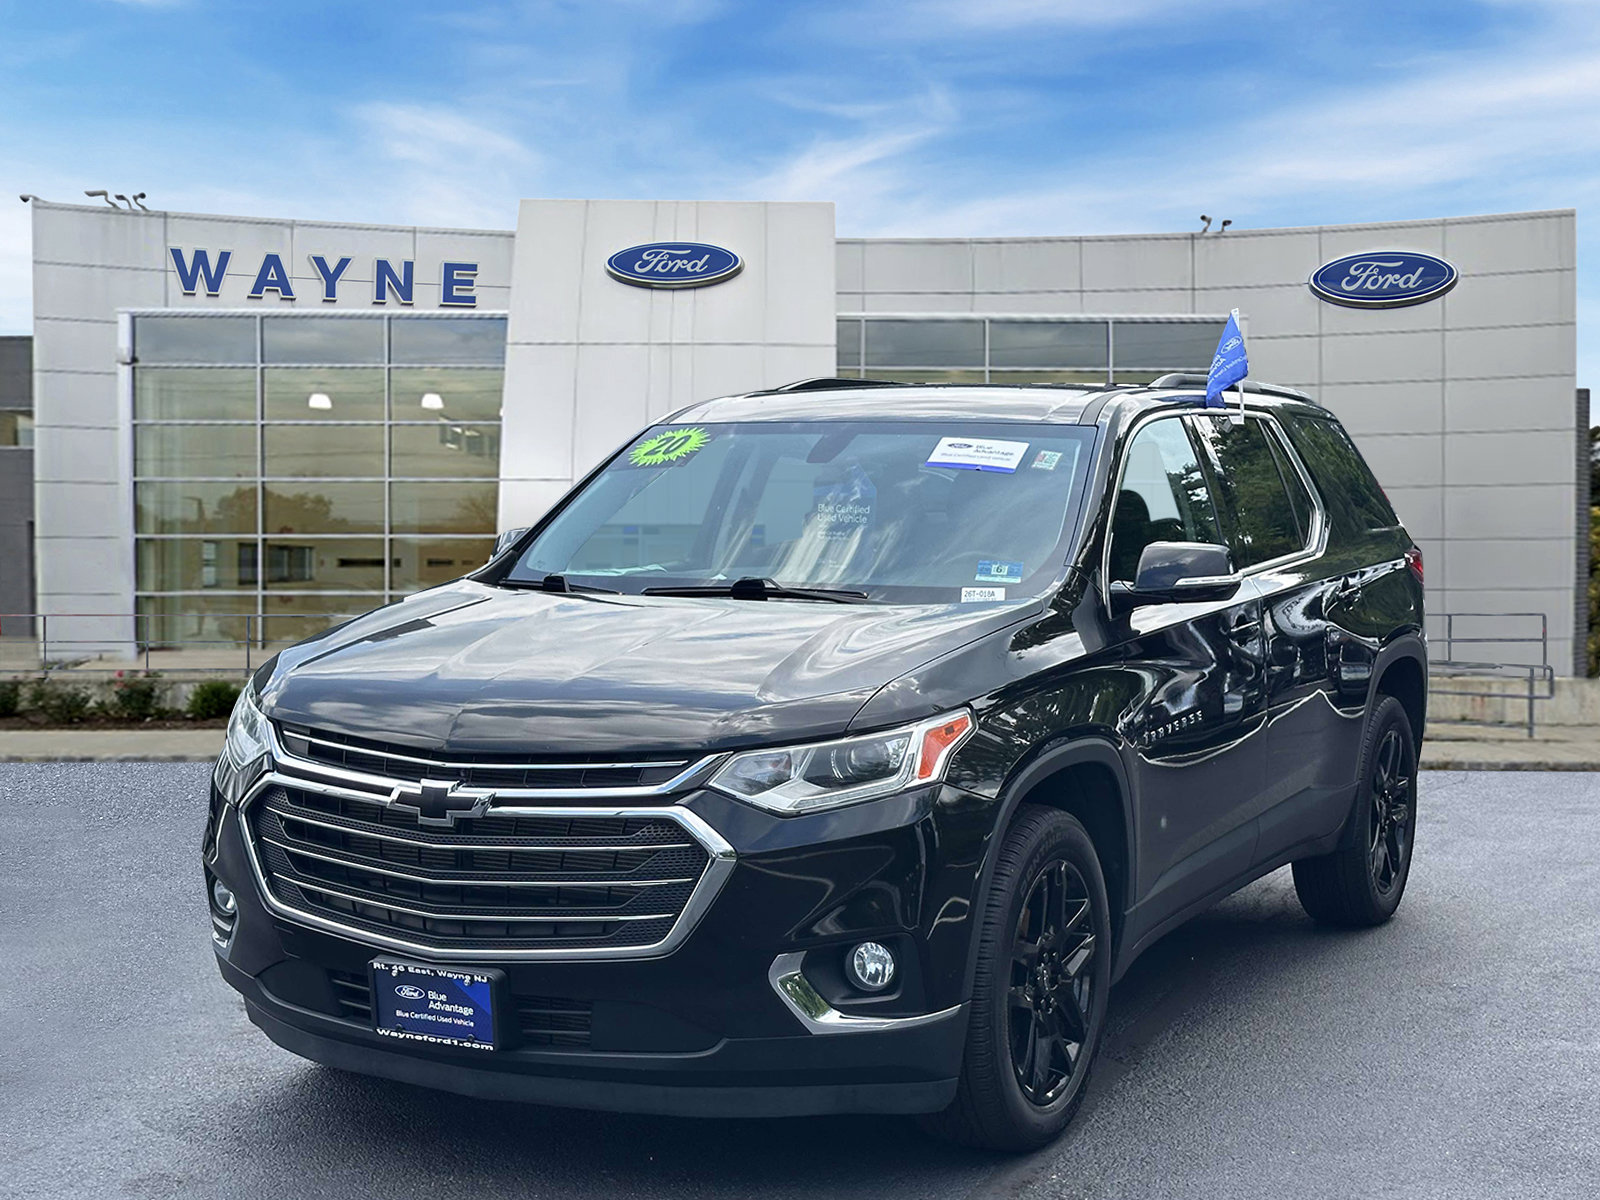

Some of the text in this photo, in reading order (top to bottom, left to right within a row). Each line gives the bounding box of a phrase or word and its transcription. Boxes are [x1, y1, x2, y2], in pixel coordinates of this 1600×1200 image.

[634, 249, 711, 273] Ford
[169, 246, 479, 306] WAYNE
[1341, 261, 1425, 291] Ford
[643, 435, 692, 457] 20
[836, 504, 871, 514] Certified
[838, 513, 868, 524] Vehicle
[436, 970, 472, 981] Wayne
[474, 975, 488, 983] NJ
[428, 990, 447, 1002] Blue
[428, 1000, 474, 1016] Advantage
[395, 1009, 474, 1027] Blue Certified Used Vehicle
[376, 1028, 494, 1051] Wayneford1.com
